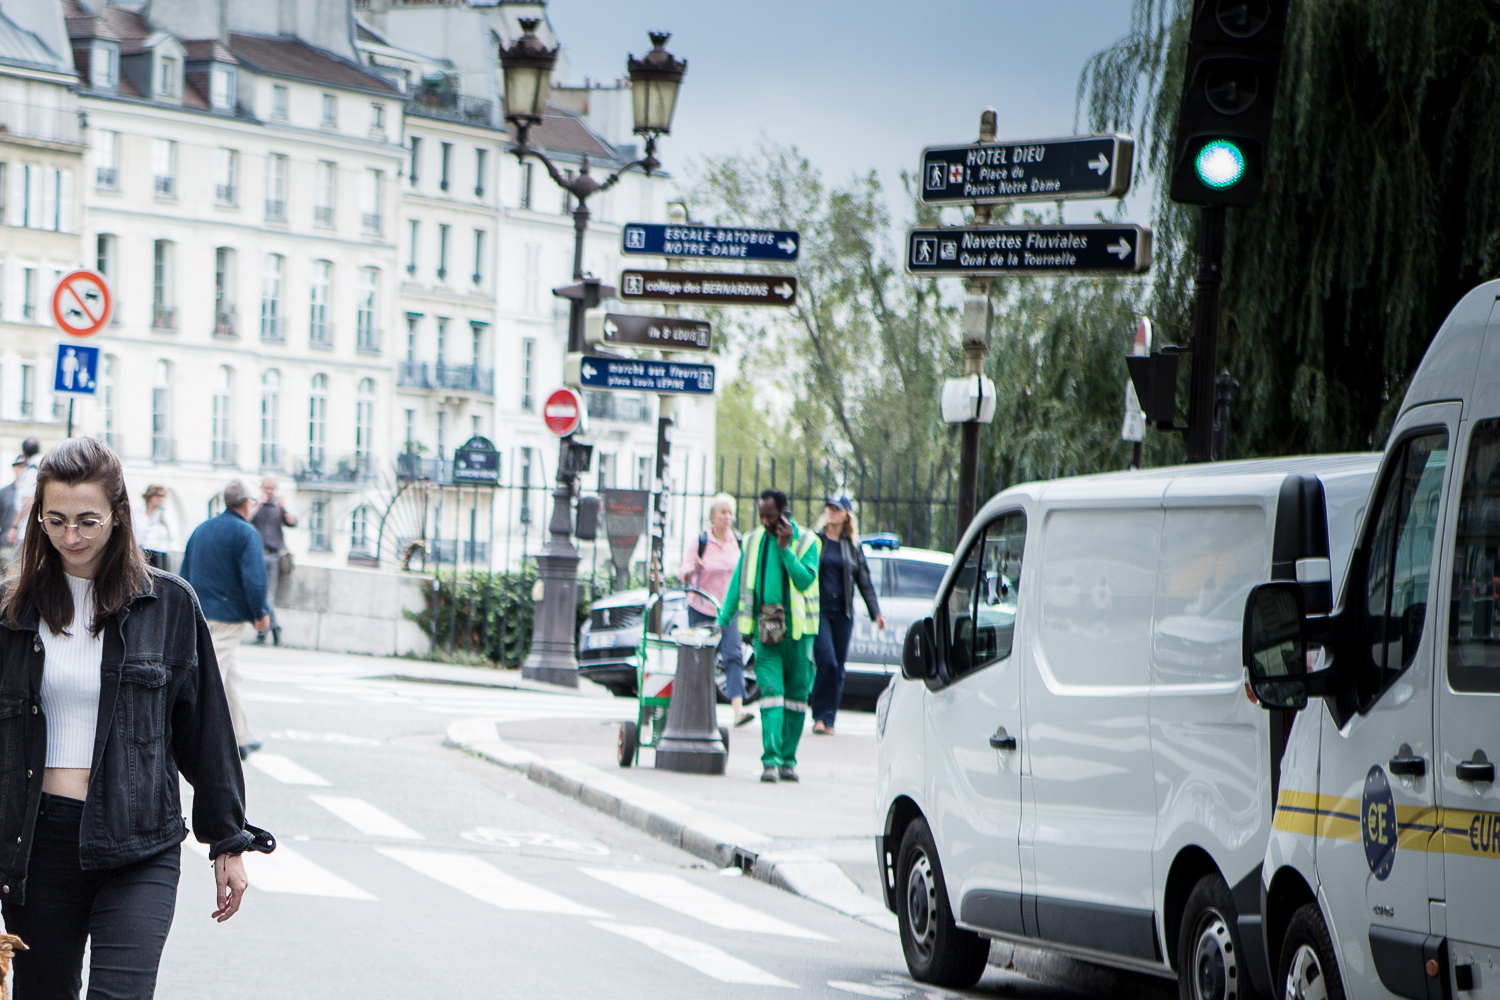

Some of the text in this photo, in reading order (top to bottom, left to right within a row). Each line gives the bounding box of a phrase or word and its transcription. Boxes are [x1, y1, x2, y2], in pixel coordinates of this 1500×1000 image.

[966, 146, 1045, 166] HOTEL DIEU
[979, 166, 1008, 180] Place
[1011, 165, 1024, 179] du
[964, 178, 1061, 196] Parvis Notre Dame
[664, 228, 775, 244] ESCALE-BATOBUS
[962, 232, 1088, 249] Navettes Fluviales
[664, 241, 748, 257] NOTRE-DAME
[960, 251, 1076, 266] Quai de la Tournelle
[683, 281, 701, 294] des
[702, 281, 769, 296] BERNARDINS
[647, 365, 666, 376] aux
[669, 365, 698, 379] fleurs
